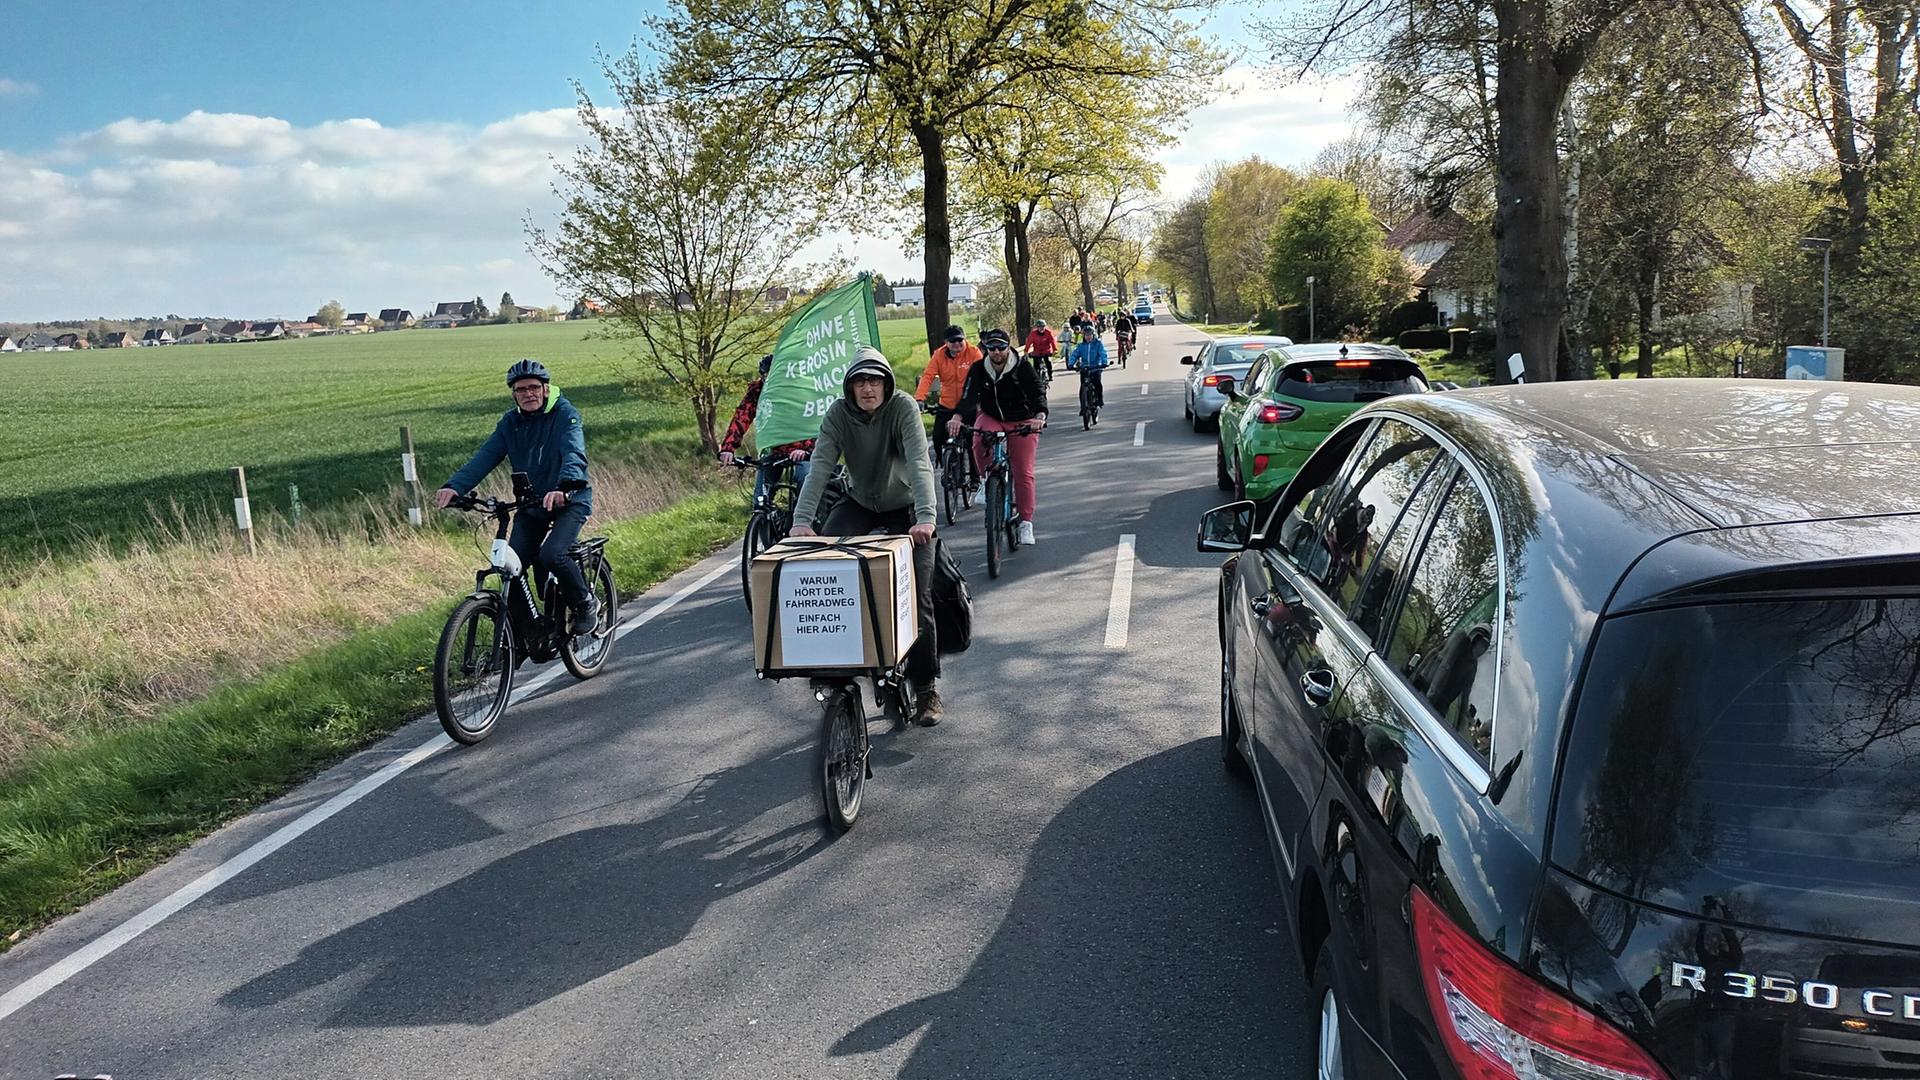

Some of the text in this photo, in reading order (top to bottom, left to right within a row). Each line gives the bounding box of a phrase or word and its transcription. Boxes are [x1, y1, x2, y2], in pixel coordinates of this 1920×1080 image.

[806, 315, 844, 348] OHNE
[785, 340, 846, 378] KEROSIN
[803, 393, 845, 417] BER
[800, 576, 837, 585] WARUM
[520, 575, 539, 619] HIMIWAY
[794, 587, 844, 596] HÖRT DER
[785, 598, 855, 608] FAHRRADWEG
[798, 613, 841, 623] EINFACH
[796, 624, 847, 634] HIER AUF?
[1671, 961, 1706, 992] R
[1723, 971, 1841, 1010] 350
